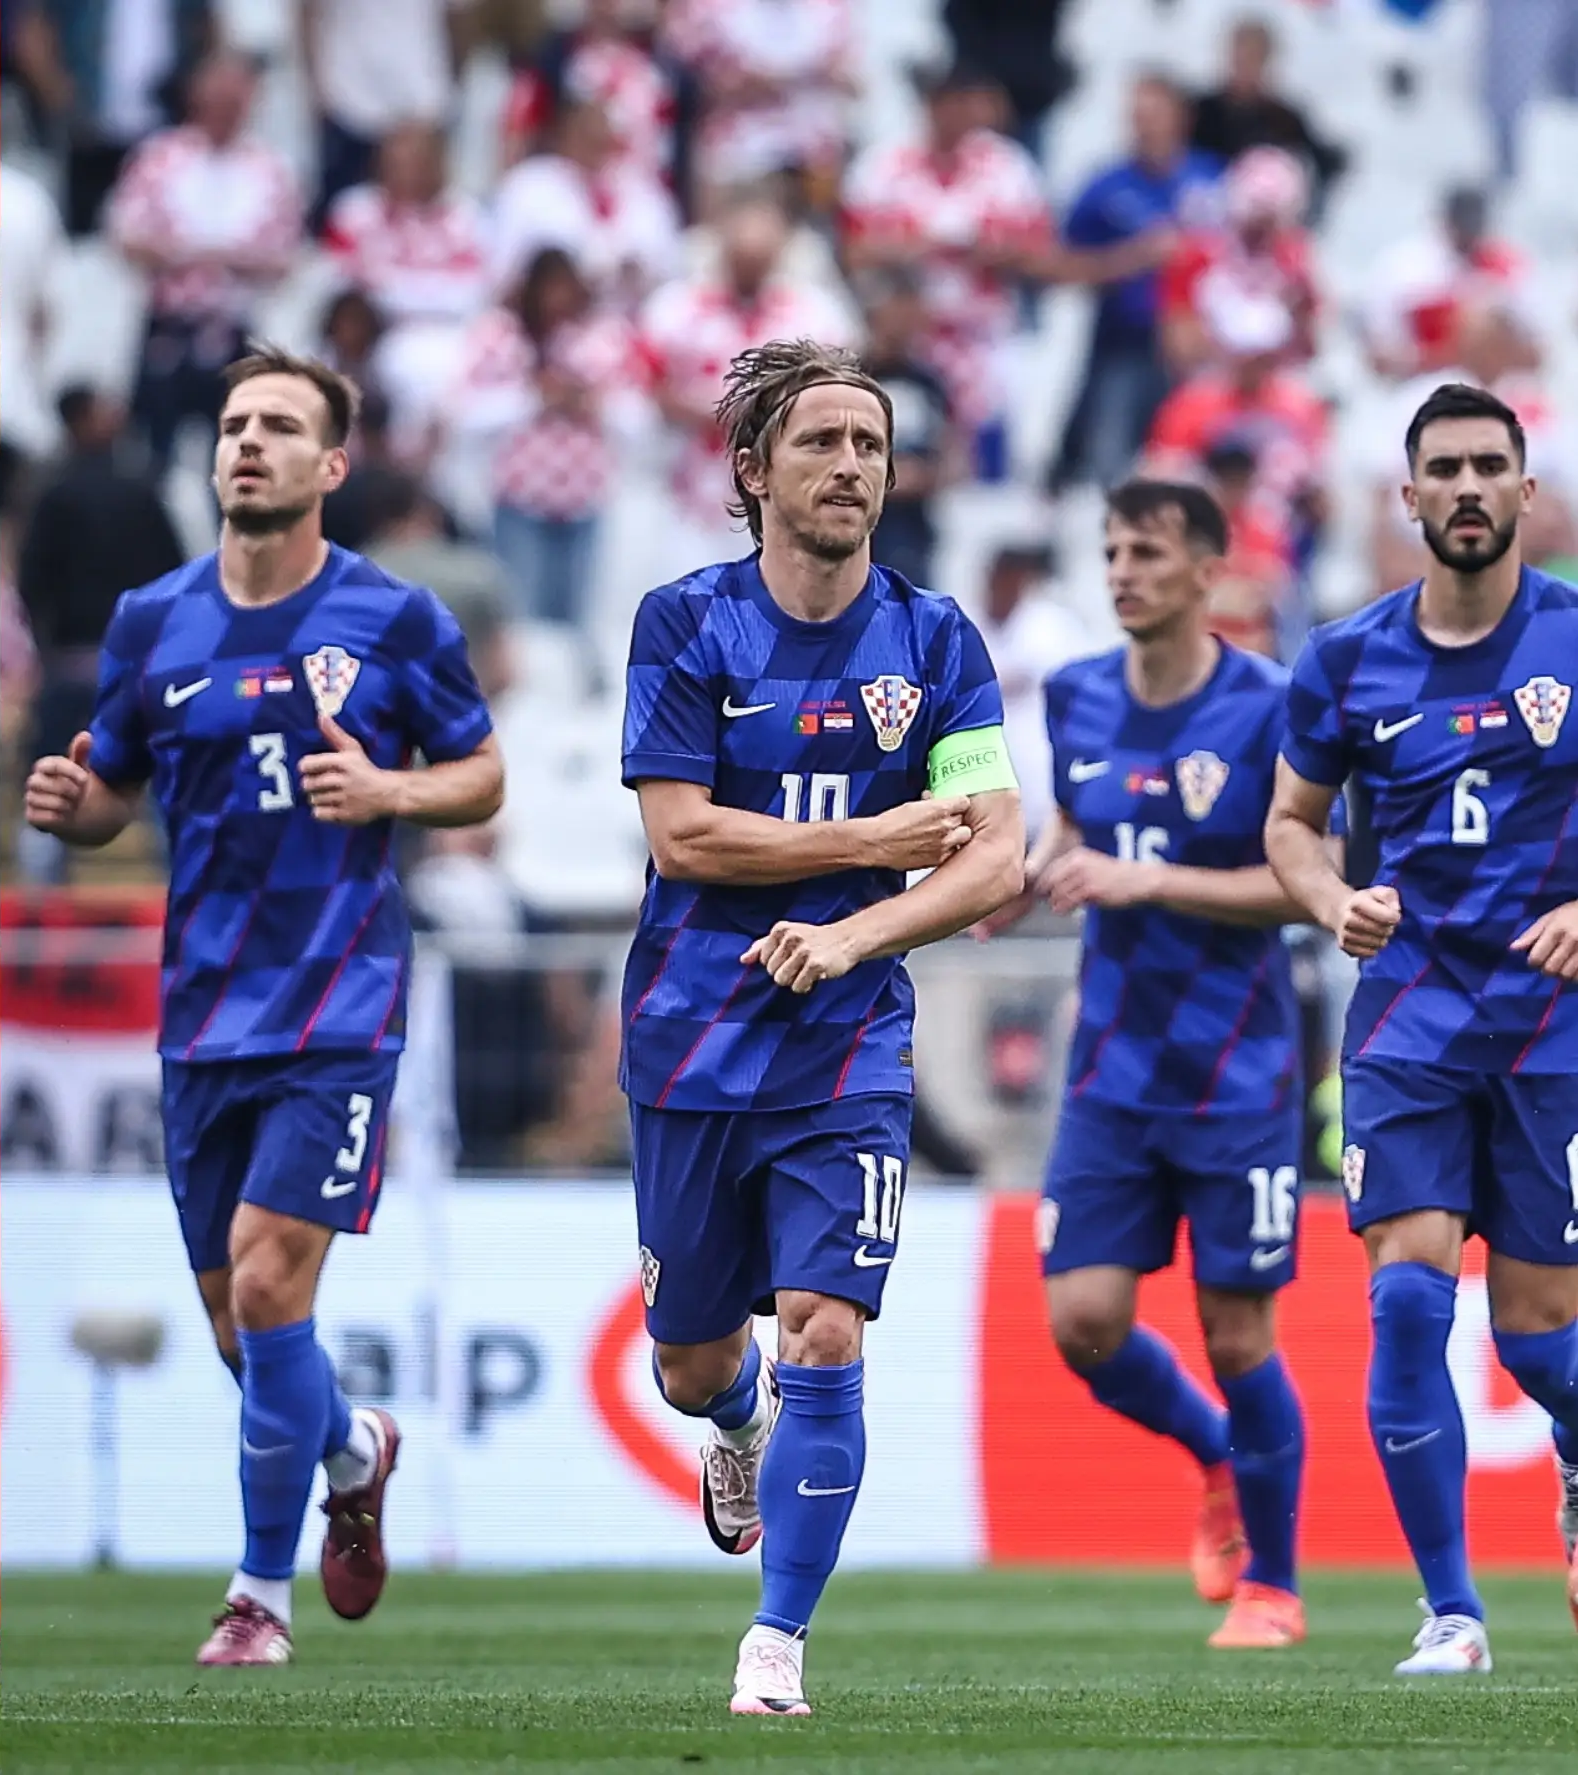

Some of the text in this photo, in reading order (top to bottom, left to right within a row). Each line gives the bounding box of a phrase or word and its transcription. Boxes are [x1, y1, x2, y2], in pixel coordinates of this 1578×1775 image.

[249, 733, 295, 811] 3
[941, 750, 997, 778] RESPECT
[1452, 768, 1491, 845] 6
[335, 1092, 373, 1173] 3
[856, 1152, 902, 1244] 10
[1247, 1165, 1298, 1241] 16
[334, 1288, 540, 1438] alp
